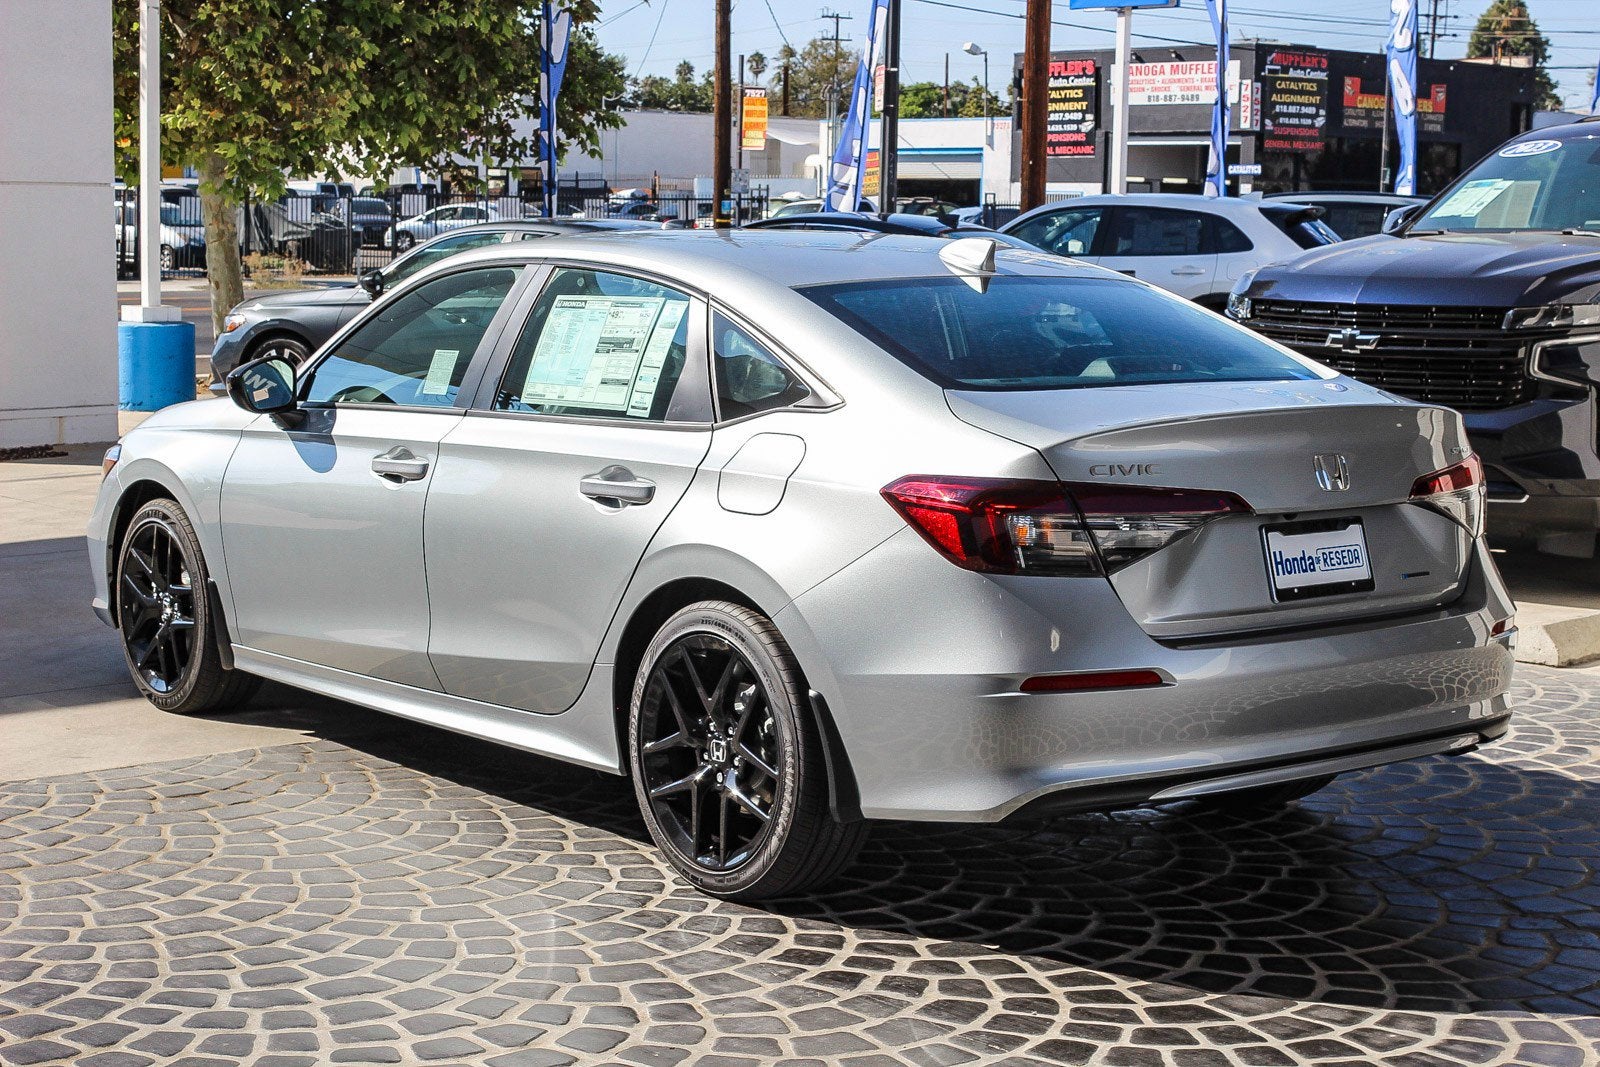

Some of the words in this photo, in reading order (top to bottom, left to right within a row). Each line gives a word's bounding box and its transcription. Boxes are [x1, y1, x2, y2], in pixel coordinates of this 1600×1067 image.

[1048, 60, 1095, 76] FFLER'S
[1128, 65, 1165, 76] ANOGA
[1289, 68, 1304, 77] Auto
[1305, 69, 1328, 77] Center
[1049, 78, 1067, 87] Auto
[1068, 76, 1095, 85] Center
[1276, 80, 1318, 91] CATALYTICS
[745, 89, 766, 97] 7527
[1048, 89, 1084, 98] ALYTICS
[1271, 94, 1322, 104] ALIGNMENT
[1356, 95, 1386, 109] CANOG
[1047, 112, 1083, 121] .887.9489
[1274, 127, 1319, 136] SUSPENSIONS
[1047, 133, 1087, 142] PENSIONS
[1263, 140, 1292, 149] GENERAL
[1056, 146, 1095, 155] MECHANIC
[1089, 464, 1165, 477] CIVIC
[1273, 550, 1316, 576] Honda
[1322, 549, 1361, 567] RESEDA
